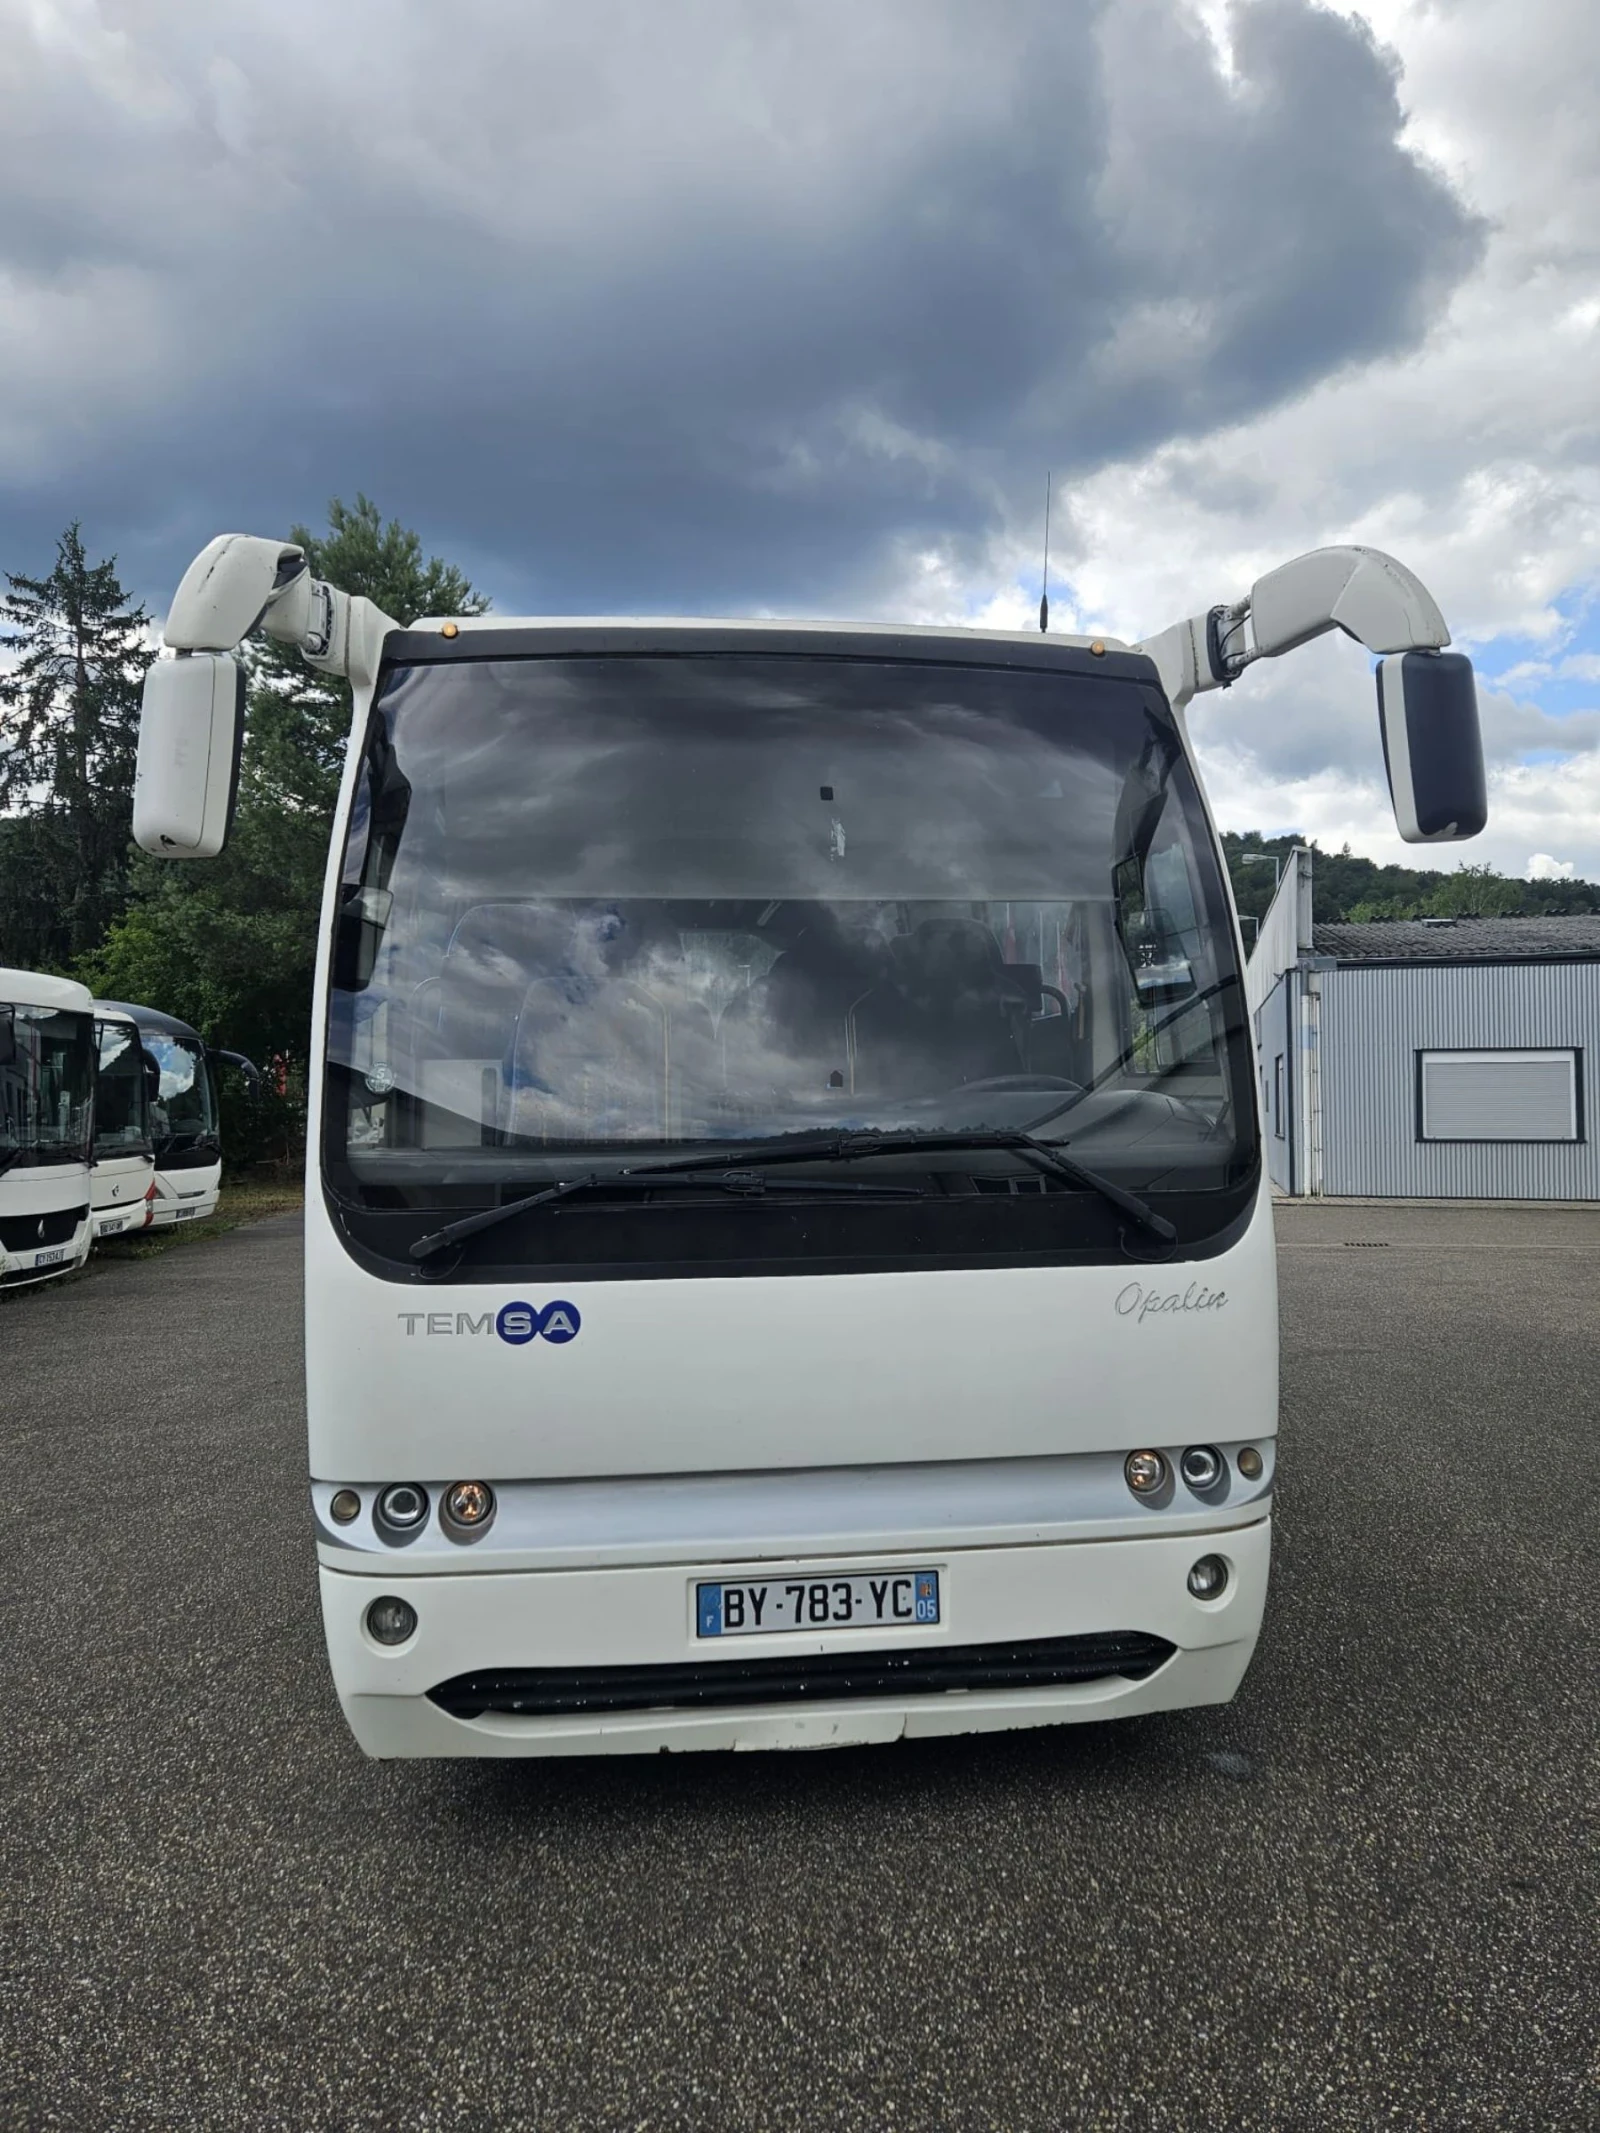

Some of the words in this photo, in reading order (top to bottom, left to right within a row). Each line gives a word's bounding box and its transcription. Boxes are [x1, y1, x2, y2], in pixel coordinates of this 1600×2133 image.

[1115, 1281, 1229, 1323] Opalin
[397, 1310, 576, 1337] TEMSA
[705, 1615, 715, 1628] F
[916, 1600, 936, 1619] 05
